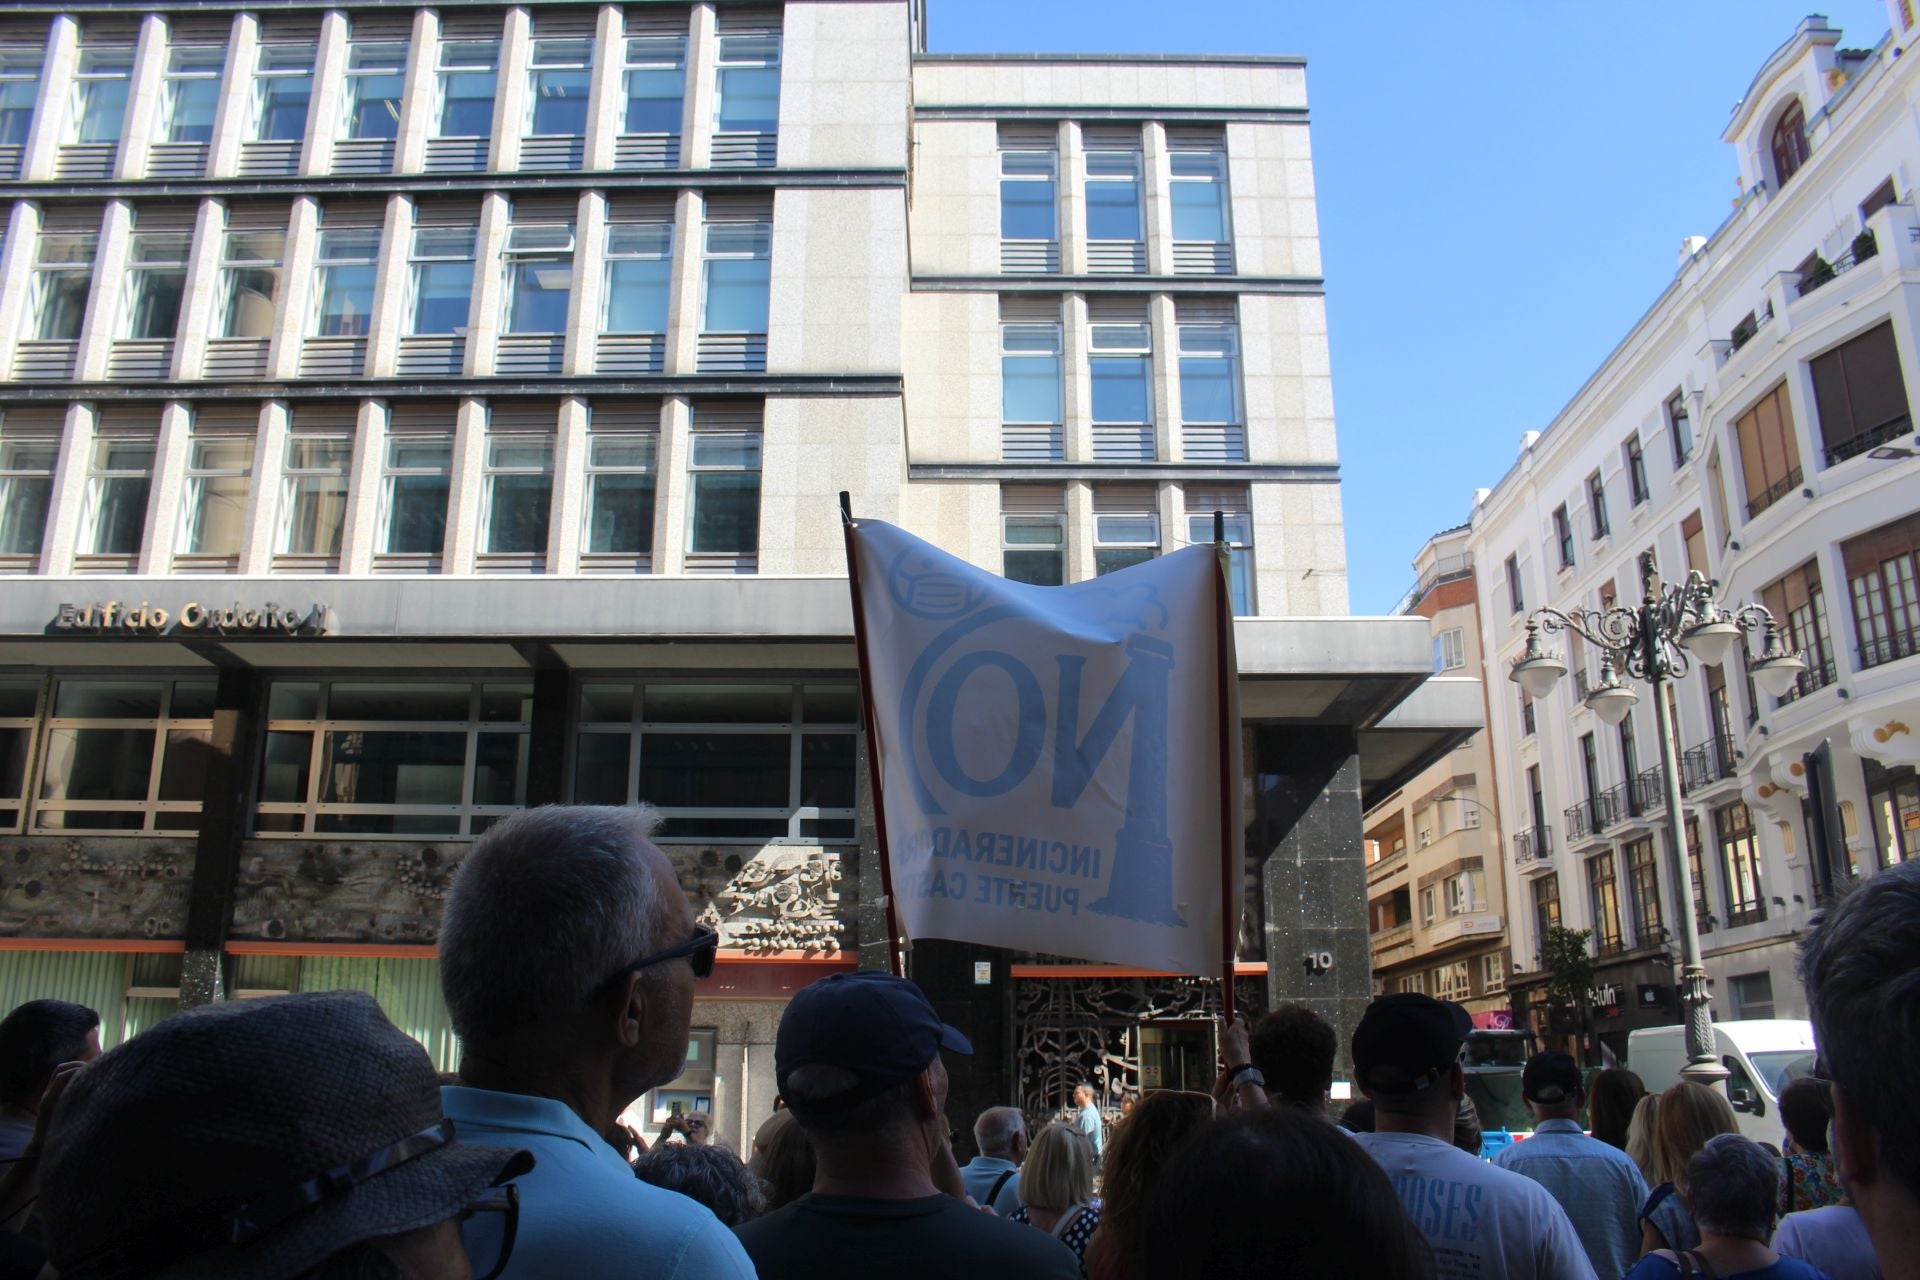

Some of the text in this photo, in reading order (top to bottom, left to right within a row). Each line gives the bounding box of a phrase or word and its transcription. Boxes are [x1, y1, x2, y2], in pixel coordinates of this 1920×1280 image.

[56, 601, 169, 629] Edificio
[179, 601, 302, 629] Ordoño
[1309, 952, 1332, 969] 10
